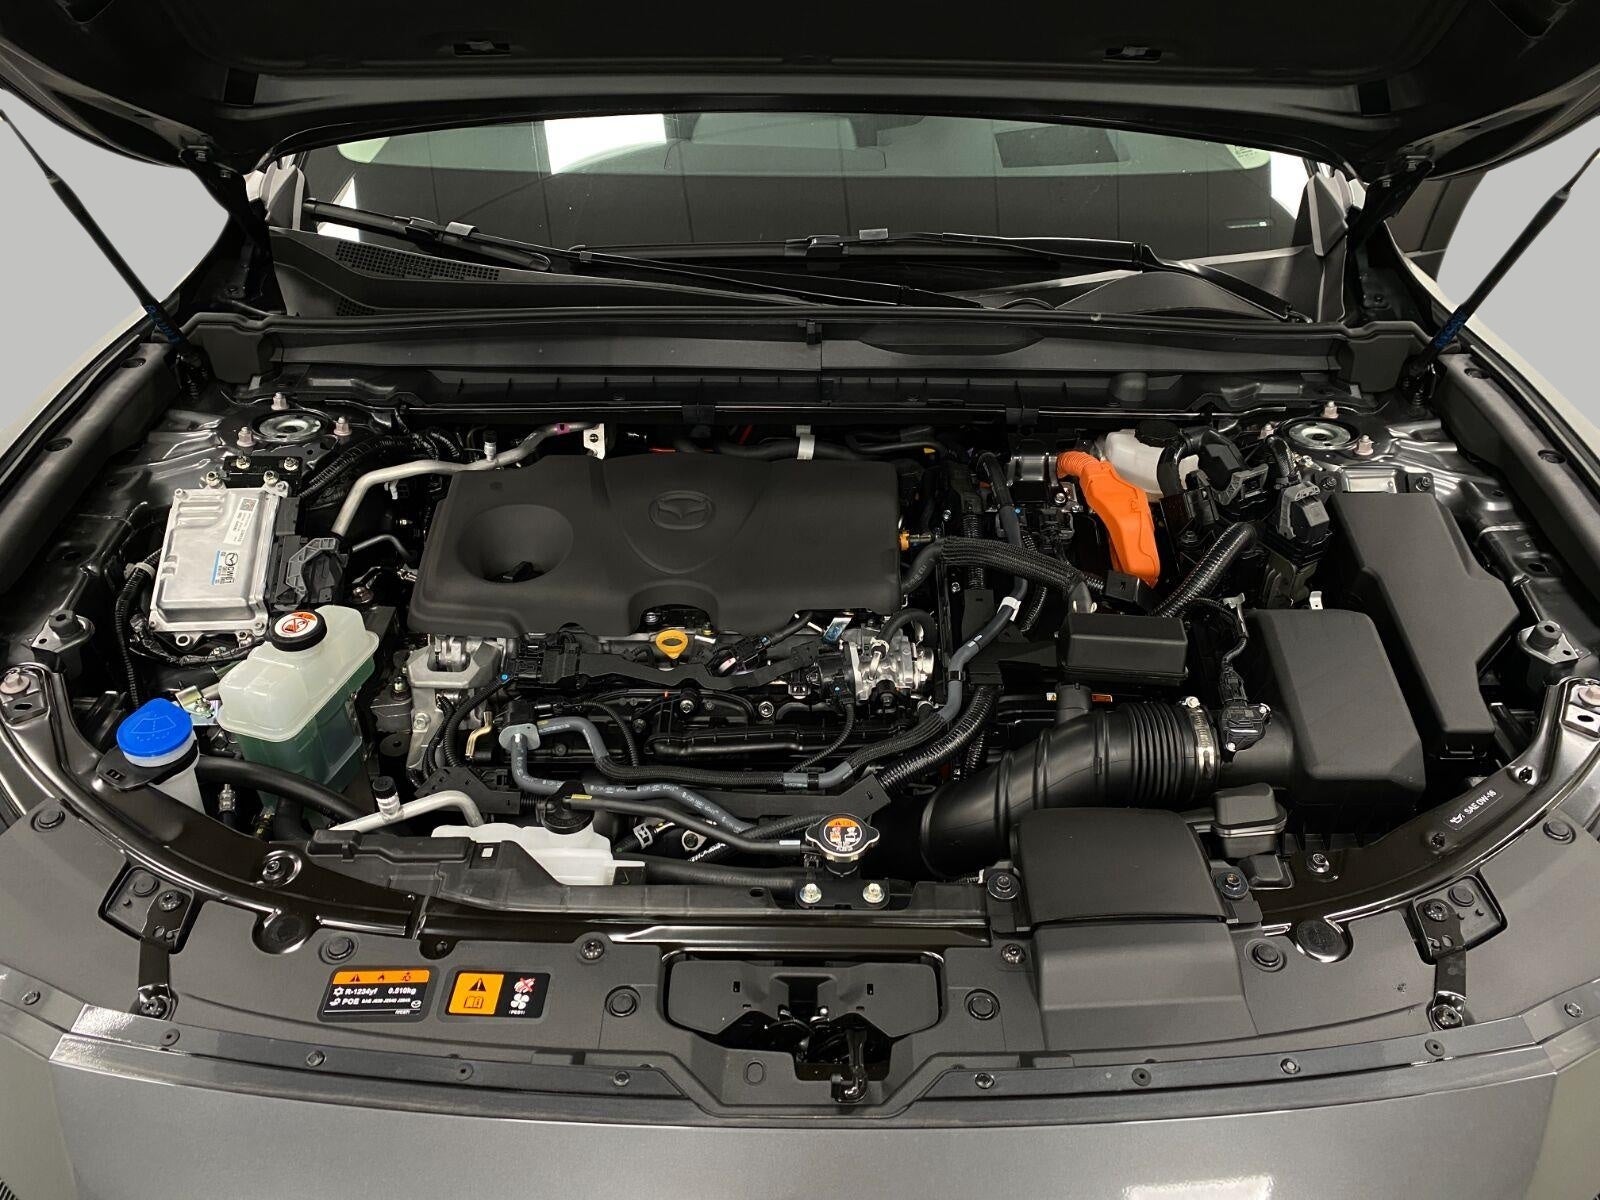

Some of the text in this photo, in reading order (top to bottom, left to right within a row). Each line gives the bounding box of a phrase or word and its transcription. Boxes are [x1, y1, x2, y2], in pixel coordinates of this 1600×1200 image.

[1464, 802, 1480, 814] SAE
[344, 987, 378, 996] R-1234yf
[341, 998, 360, 1006] POE
